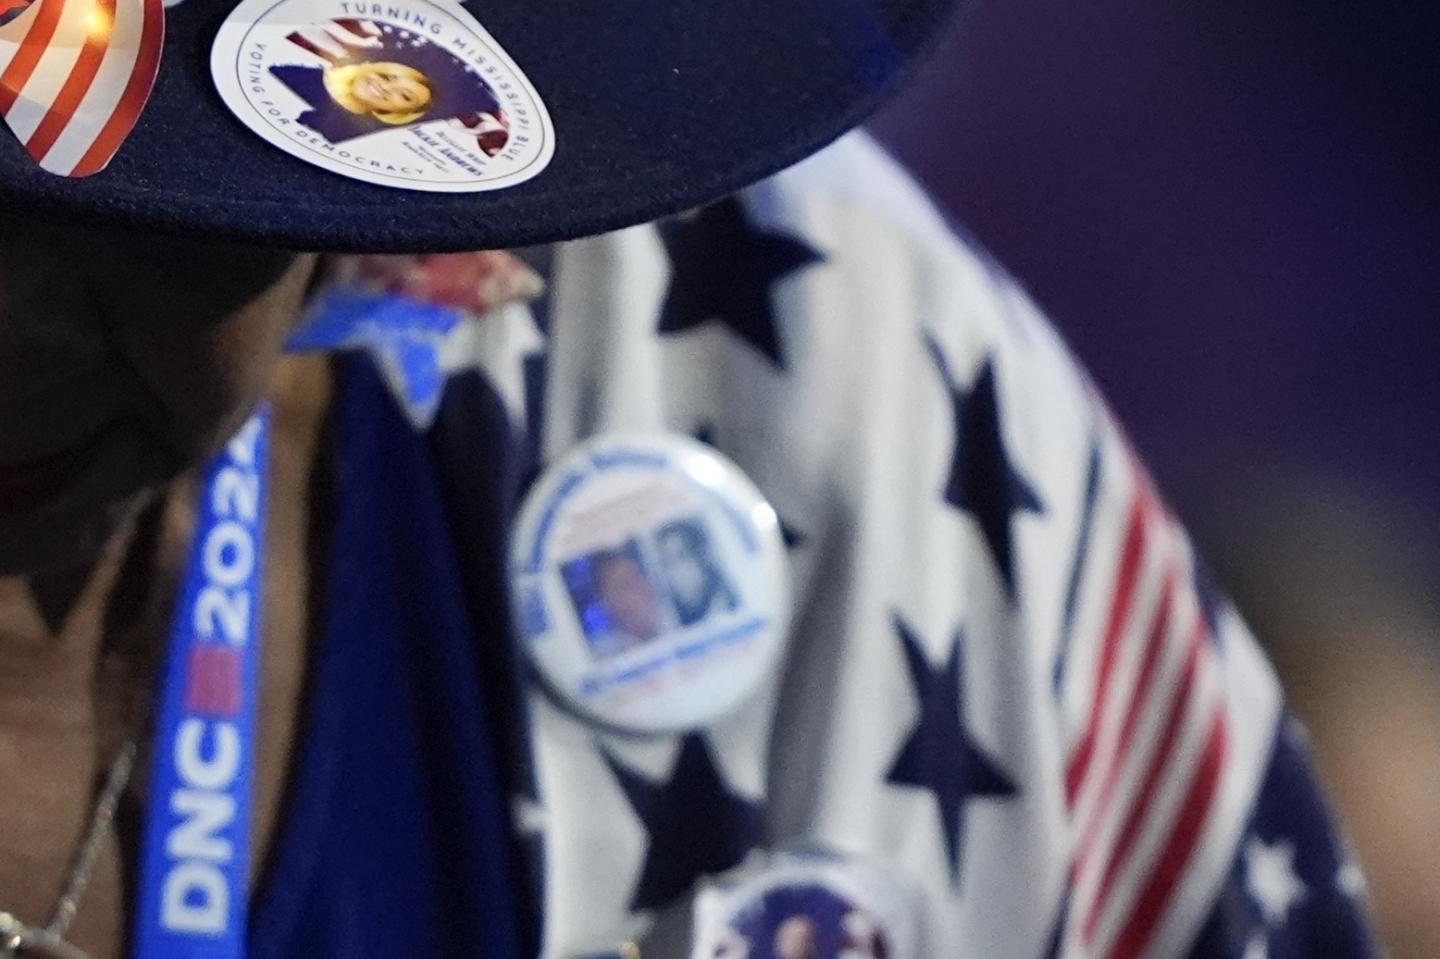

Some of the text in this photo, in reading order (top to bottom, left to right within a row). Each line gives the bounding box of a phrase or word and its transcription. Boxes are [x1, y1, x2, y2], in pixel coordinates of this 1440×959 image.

[248, 42, 268, 94] VOTING
[261, 100, 290, 125] FOR
[296, 130, 424, 174] DEMOCRACY
[341, 0, 443, 35] TURNING
[452, 37, 529, 129] MISSISSIPPI
[160, 717, 241, 934] DNC
